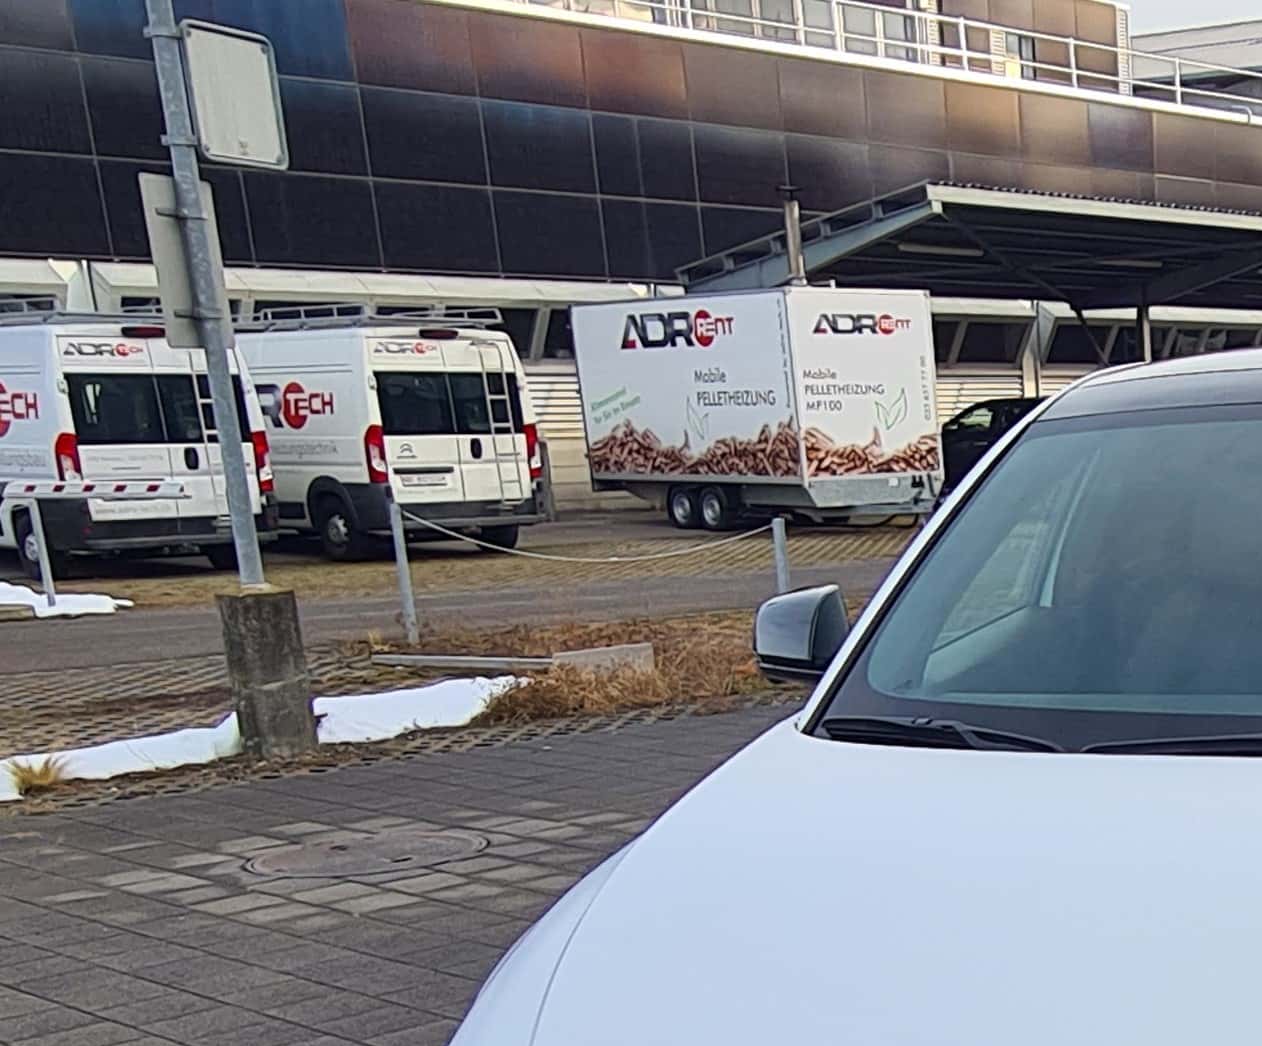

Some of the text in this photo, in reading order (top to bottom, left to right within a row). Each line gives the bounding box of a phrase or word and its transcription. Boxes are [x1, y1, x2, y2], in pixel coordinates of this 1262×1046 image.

[694, 367, 727, 384] Mobile
[803, 368, 837, 380] Mobile
[804, 384, 885, 396] PELLETHEIZUNG
[697, 389, 776, 407] PELLETHEIZUNG
